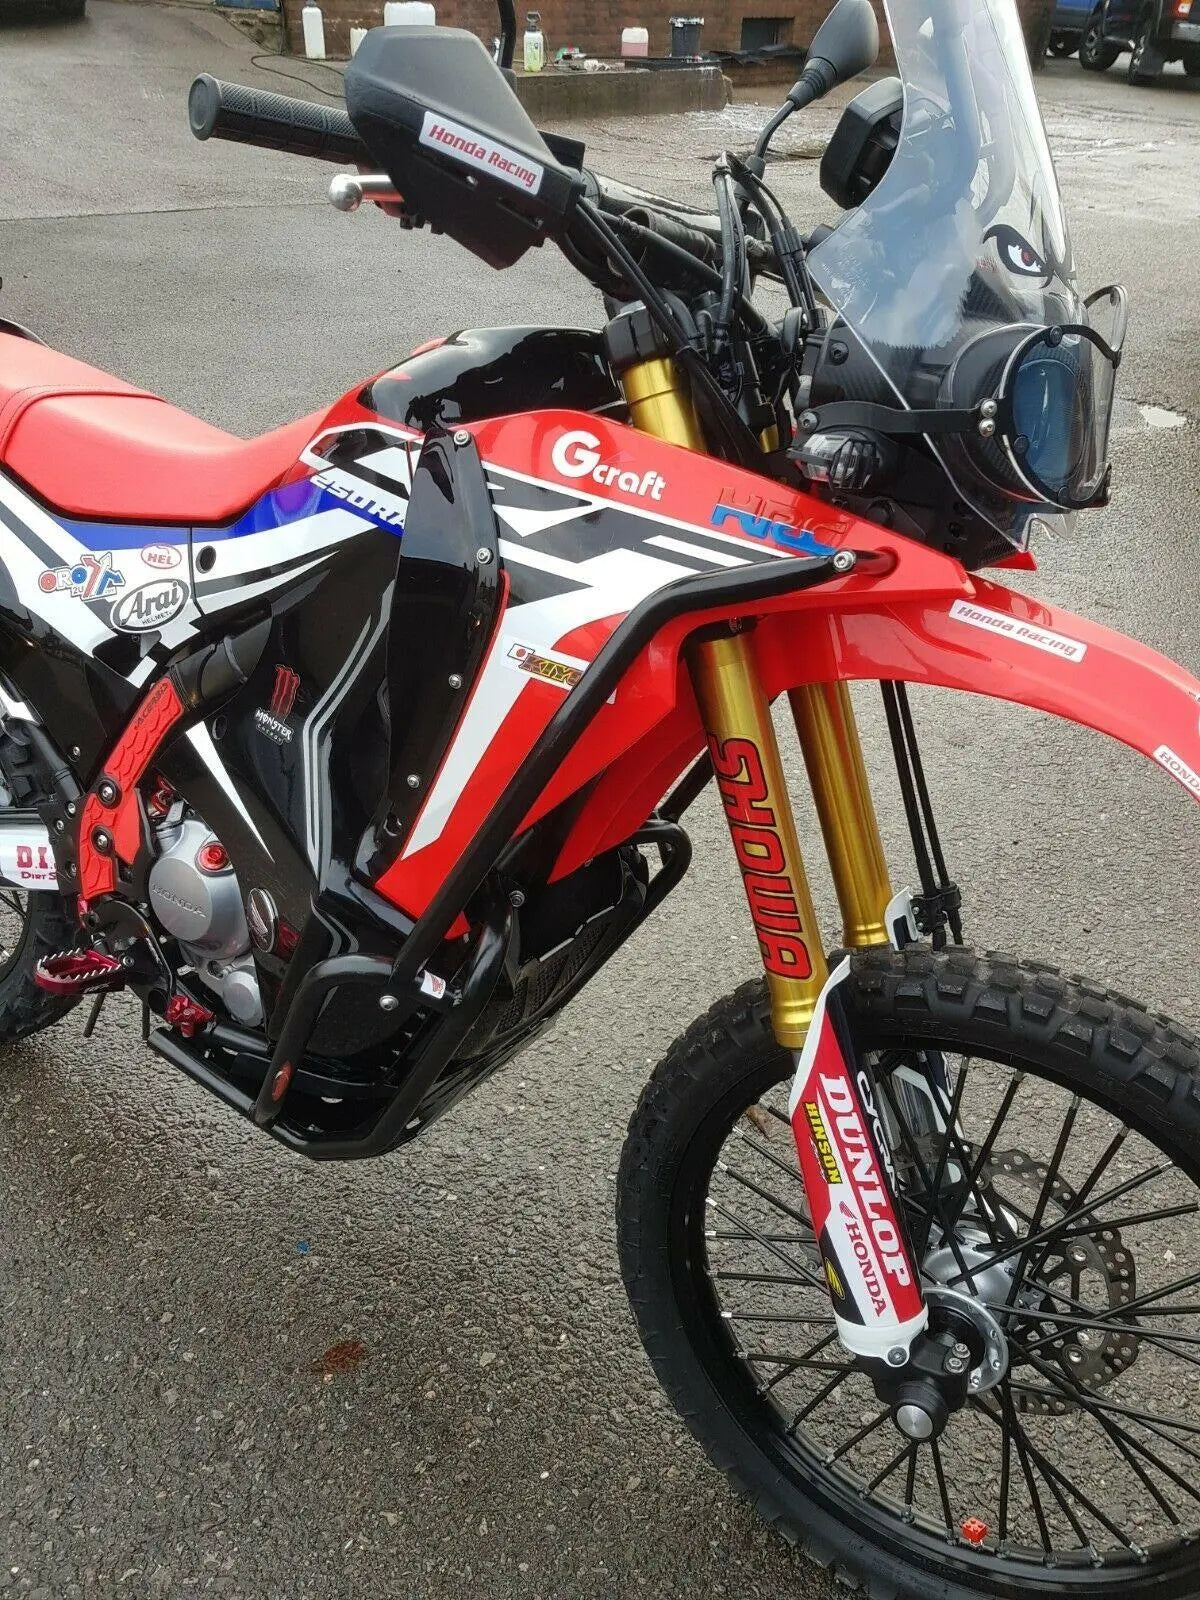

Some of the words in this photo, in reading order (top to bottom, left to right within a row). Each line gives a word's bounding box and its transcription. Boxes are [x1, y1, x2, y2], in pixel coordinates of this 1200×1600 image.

[428, 124, 486, 160] Honda
[487, 151, 538, 188] Racing
[147, 552, 174, 566] HEL
[120, 581, 180, 626] Arai
[957, 606, 1014, 632] Honda
[1016, 627, 1078, 656] Racing
[255, 709, 292, 741] MONSTER
[1159, 750, 1200, 792] HOND
[708, 733, 812, 980] SHOWA
[151, 883, 207, 919] HONDA
[803, 1101, 842, 1184] HINSON
[817, 1072, 911, 1288] DUNLOP
[846, 1221, 888, 1318] HONDA
